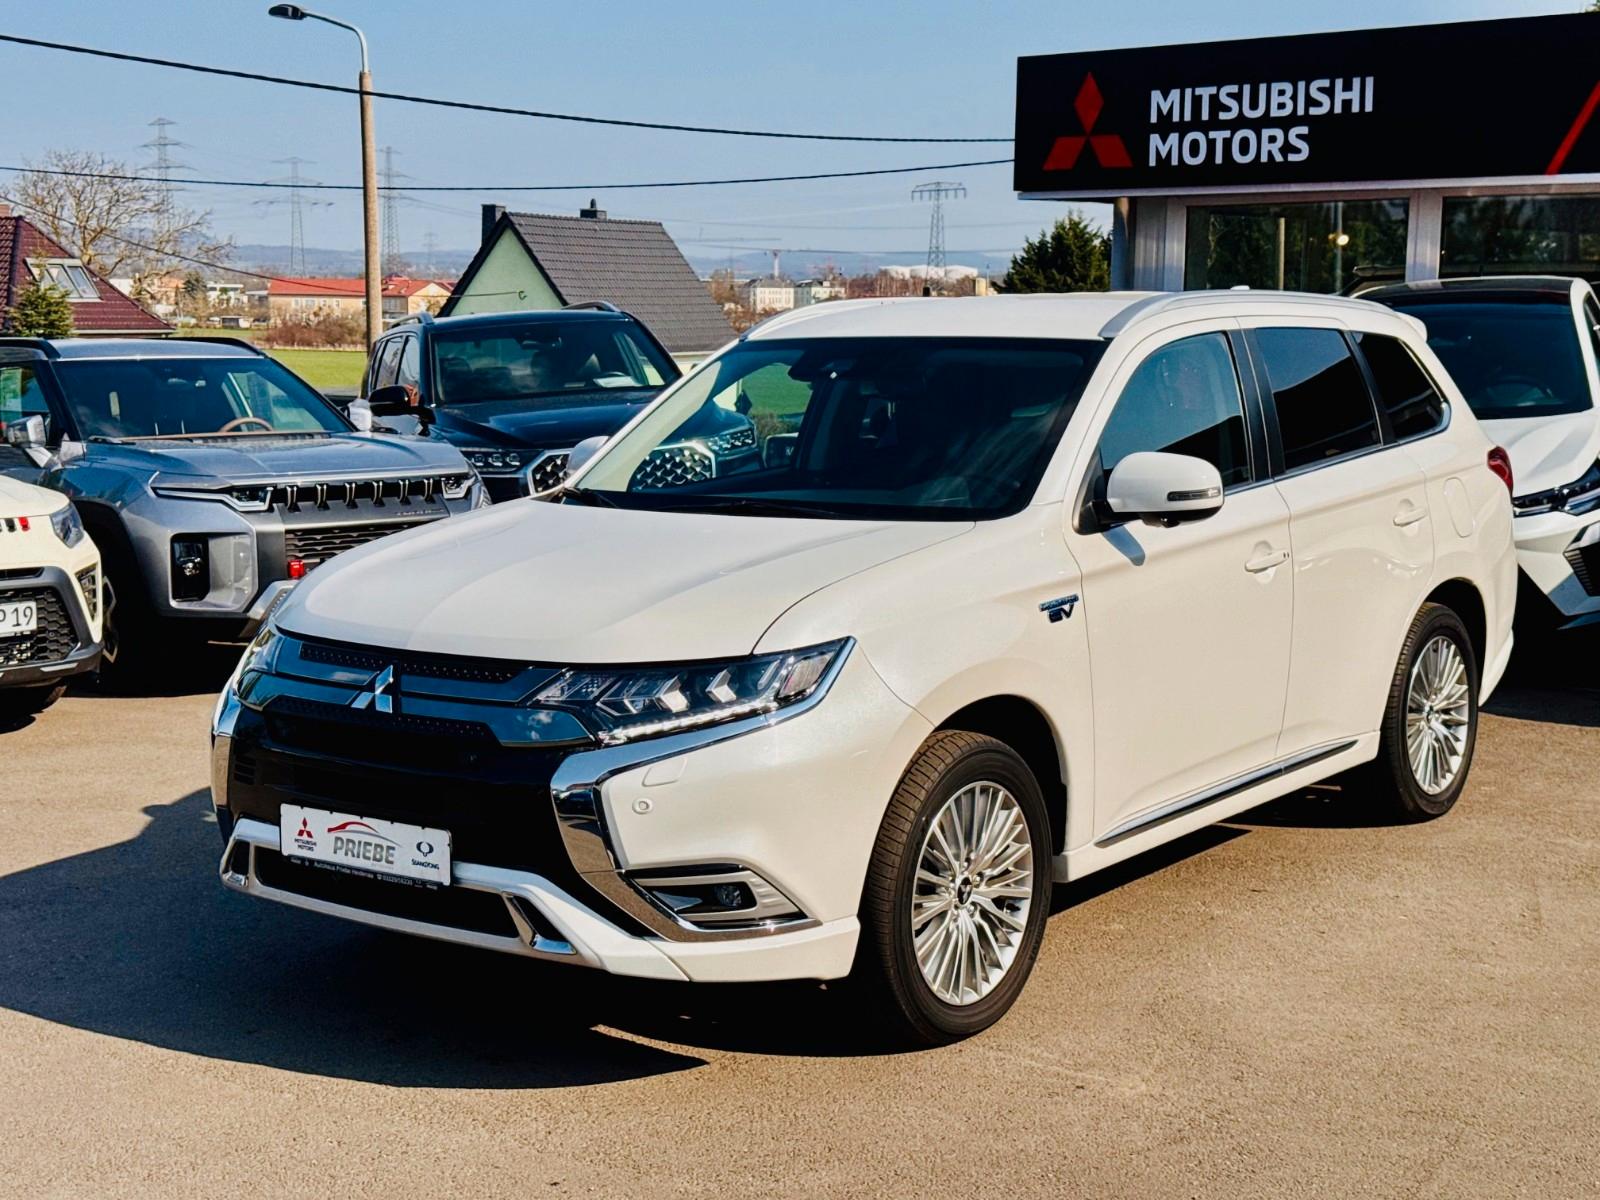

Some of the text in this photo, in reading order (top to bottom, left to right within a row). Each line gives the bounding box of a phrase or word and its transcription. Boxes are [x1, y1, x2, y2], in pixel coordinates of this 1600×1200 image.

[1150, 76, 1374, 123] MITSUBISHI
[1149, 126, 1310, 167] MOTORS
[11, 606, 33, 627] 19
[333, 836, 396, 864] PRIEBE
